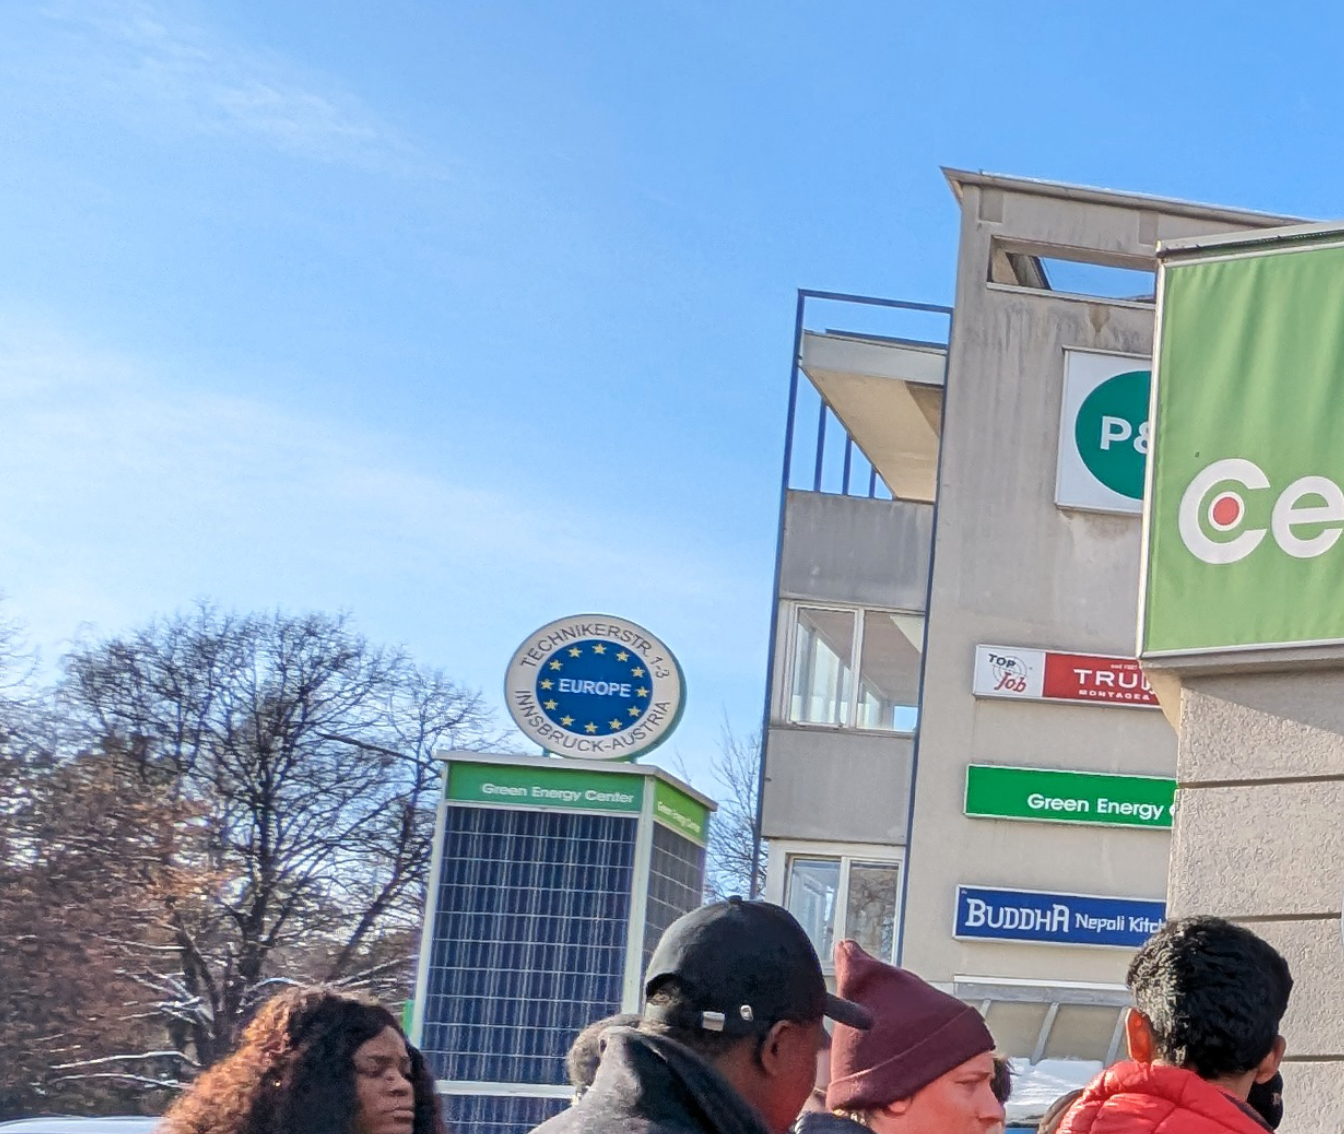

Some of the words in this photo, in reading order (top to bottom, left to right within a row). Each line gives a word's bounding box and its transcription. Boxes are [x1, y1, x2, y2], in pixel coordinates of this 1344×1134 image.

[520, 623, 652, 667] TECHNIKERSTR.
[650, 656, 670, 679] 1-3
[988, 653, 1016, 668] TOP
[558, 678, 632, 697] EUROPE
[994, 672, 1027, 693] Job
[515, 690, 671, 752] INNSBRUCK-AUSTRIA
[481, 783, 527, 797] Green
[532, 786, 581, 802] Energy
[585, 789, 635, 804] Center
[1027, 793, 1089, 812] Green
[1097, 798, 1164, 820] Energy
[965, 898, 1070, 933] BUDDHA
[1075, 913, 1125, 933] Nepali
